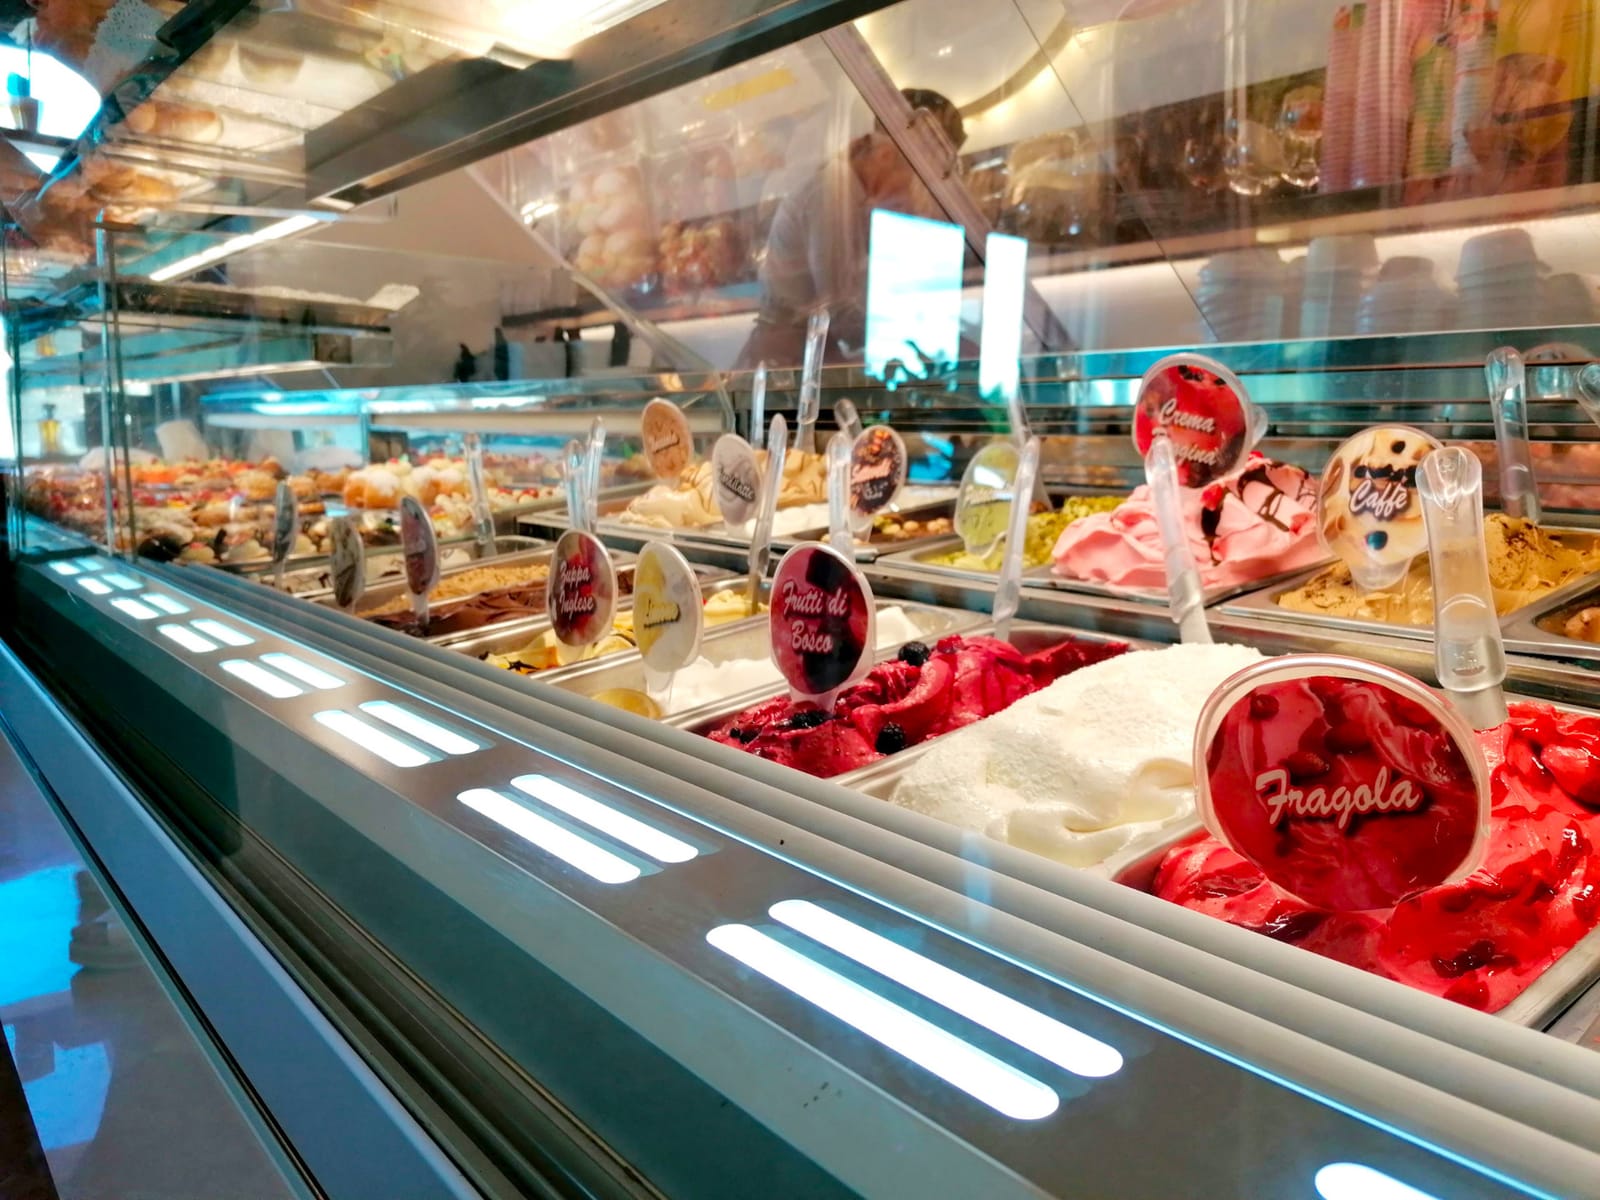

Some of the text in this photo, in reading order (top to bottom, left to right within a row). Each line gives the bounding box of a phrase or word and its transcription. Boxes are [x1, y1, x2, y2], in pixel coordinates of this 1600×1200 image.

[1159, 398, 1216, 433] Crema
[1349, 479, 1408, 517] Caffè
[560, 560, 591, 590] Zuppa
[560, 590, 594, 620] Inglese
[783, 581, 848, 615] Frutti di
[791, 620, 833, 653] Bosco
[1255, 766, 1420, 829] Fragola
